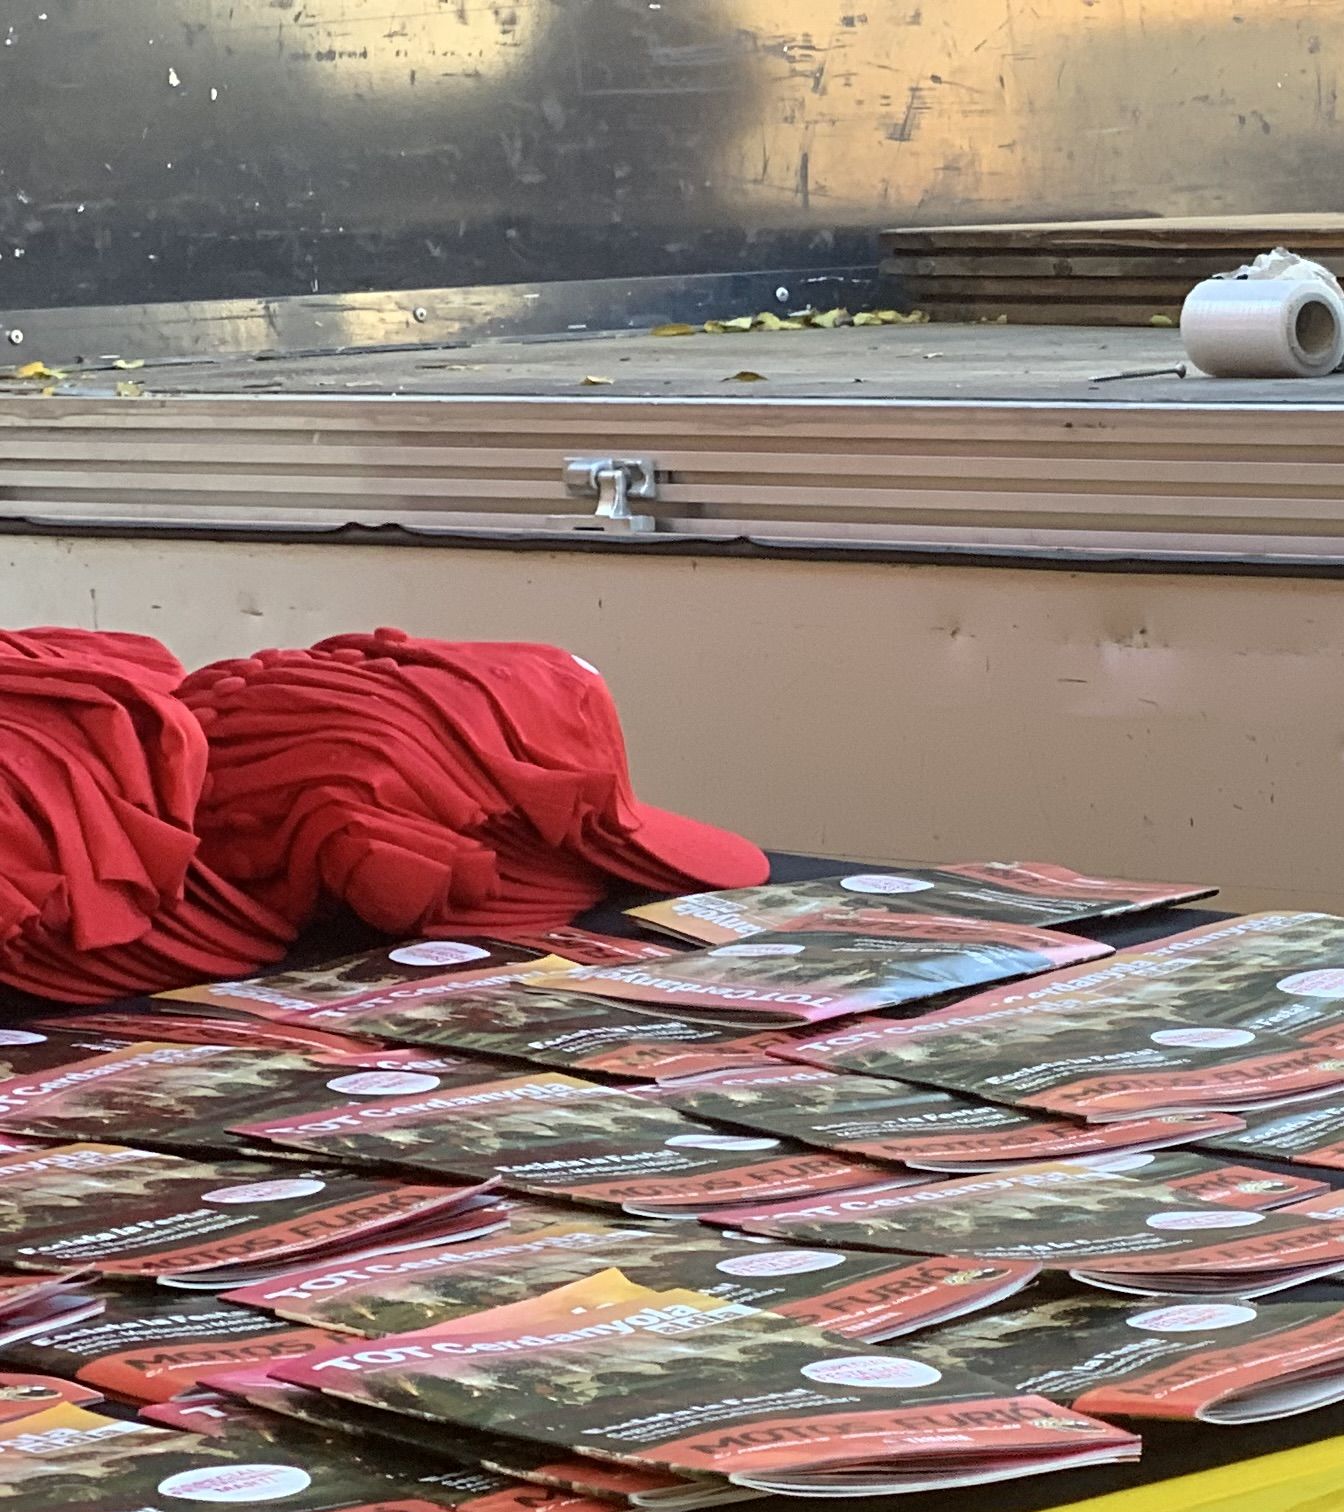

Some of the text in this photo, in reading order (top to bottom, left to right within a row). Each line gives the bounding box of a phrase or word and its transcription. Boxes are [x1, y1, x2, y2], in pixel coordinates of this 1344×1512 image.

[264, 1268, 372, 1301] TOT
[824, 1266, 960, 1313] FURIÓ
[124, 1339, 316, 1371] MOTOS
[311, 1345, 437, 1372] TOT
[431, 1304, 701, 1355] Cerdanyola
[690, 1420, 884, 1455] MOTOS
[891, 1401, 1055, 1431] FURIÓ
